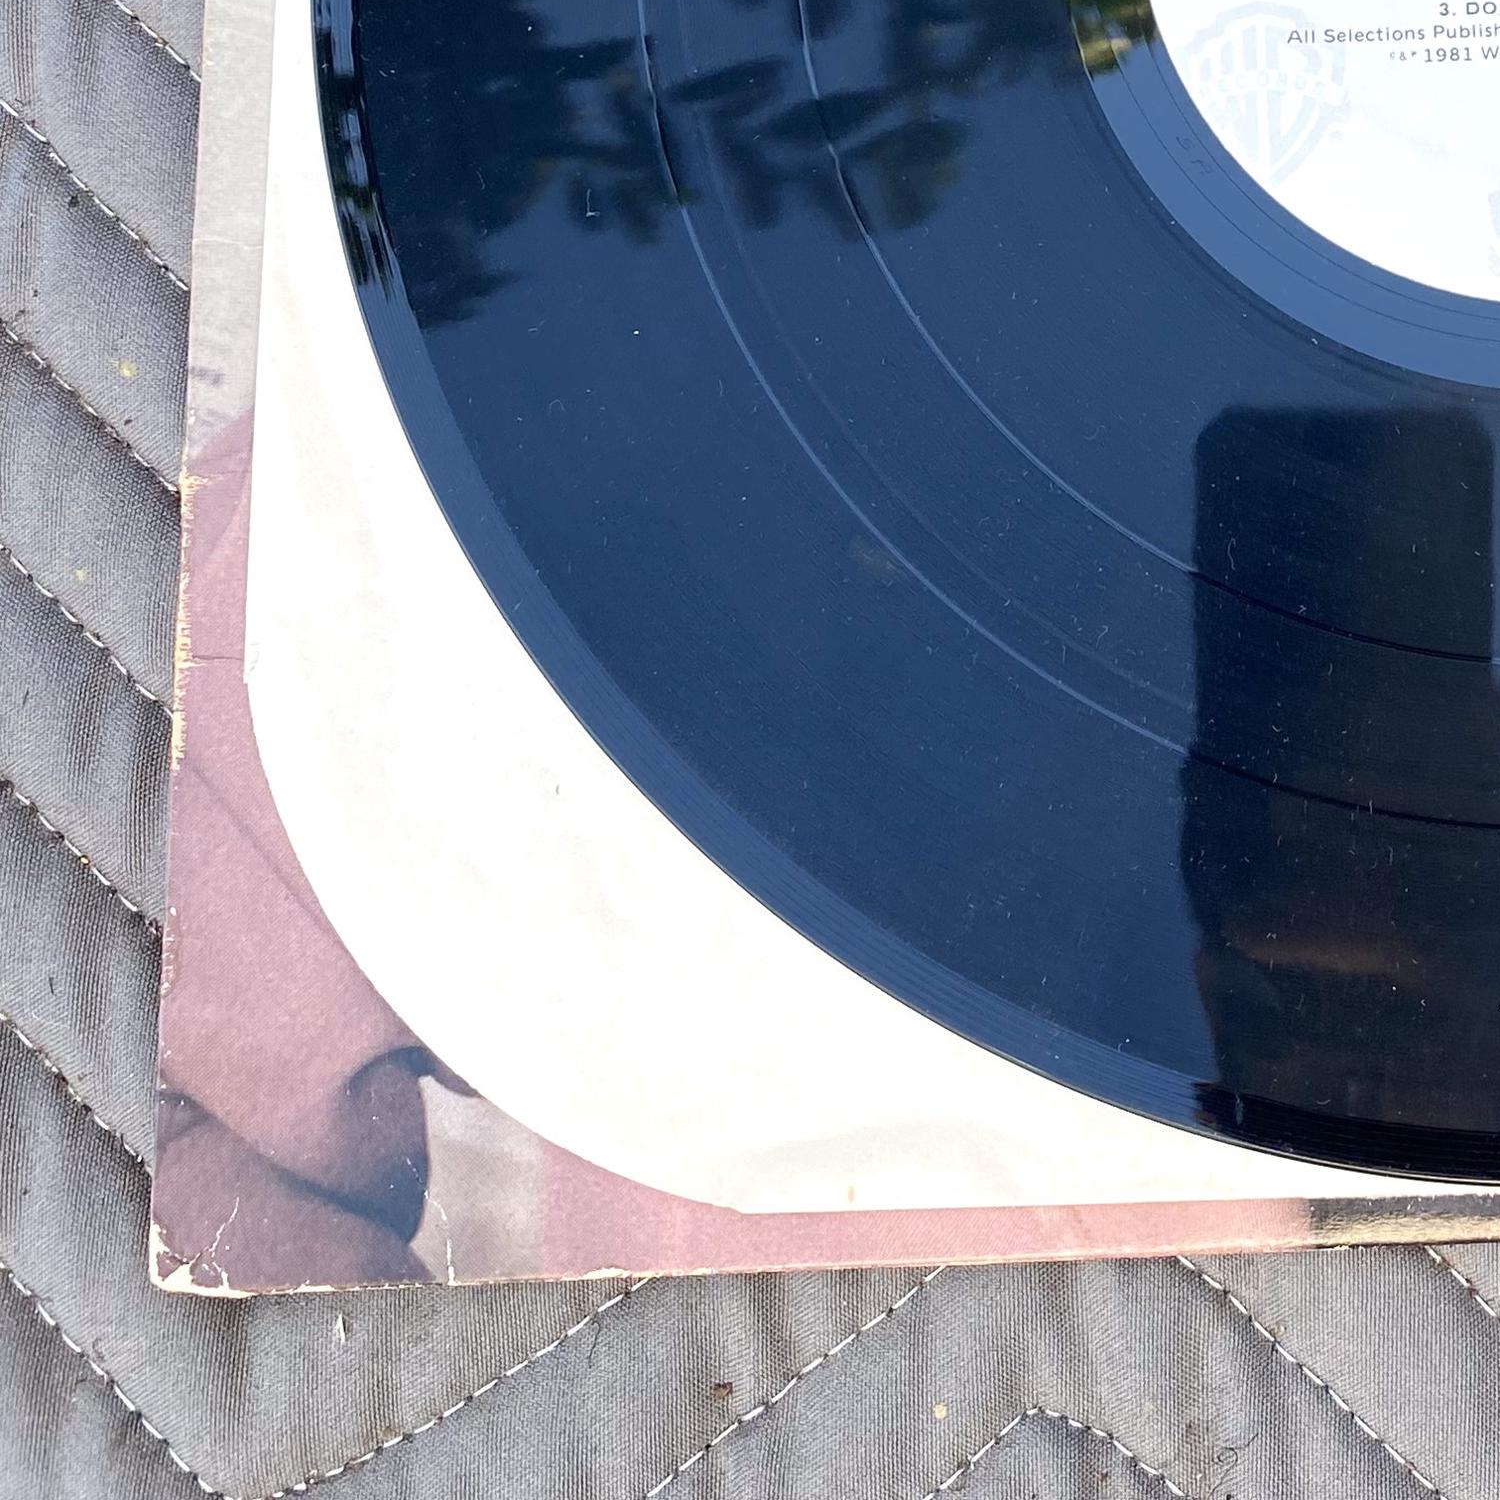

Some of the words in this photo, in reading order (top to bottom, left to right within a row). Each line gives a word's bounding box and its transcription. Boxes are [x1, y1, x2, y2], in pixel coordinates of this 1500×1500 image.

[1439, 2, 1457, 17] 3.
[1465, 1, 1497, 16] DO
[1287, 30, 1315, 44] All
[1323, 27, 1425, 44] Selections
[1424, 47, 1472, 63] 1981
